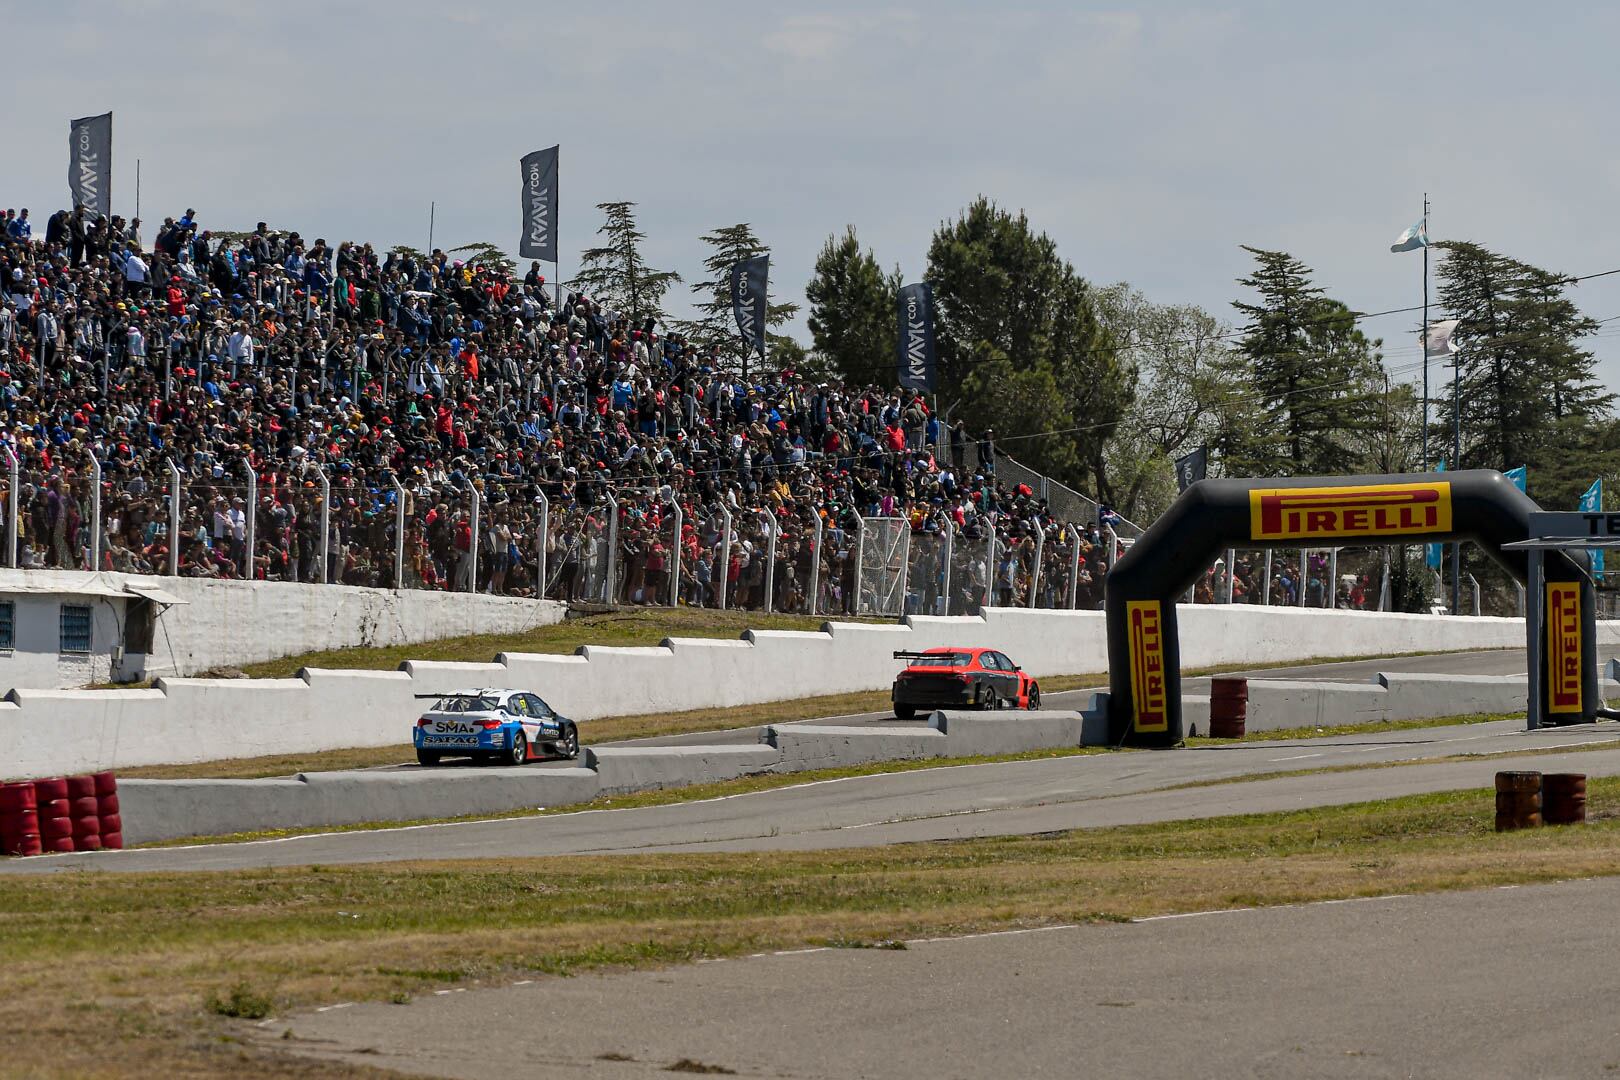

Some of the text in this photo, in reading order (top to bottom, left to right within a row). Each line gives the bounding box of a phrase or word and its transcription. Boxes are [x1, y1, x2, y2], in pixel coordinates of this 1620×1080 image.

[1261, 489, 1440, 534] PIRELLI
[1131, 608, 1164, 725] PIRELLI
[1552, 589, 1579, 706] PIRELLI
